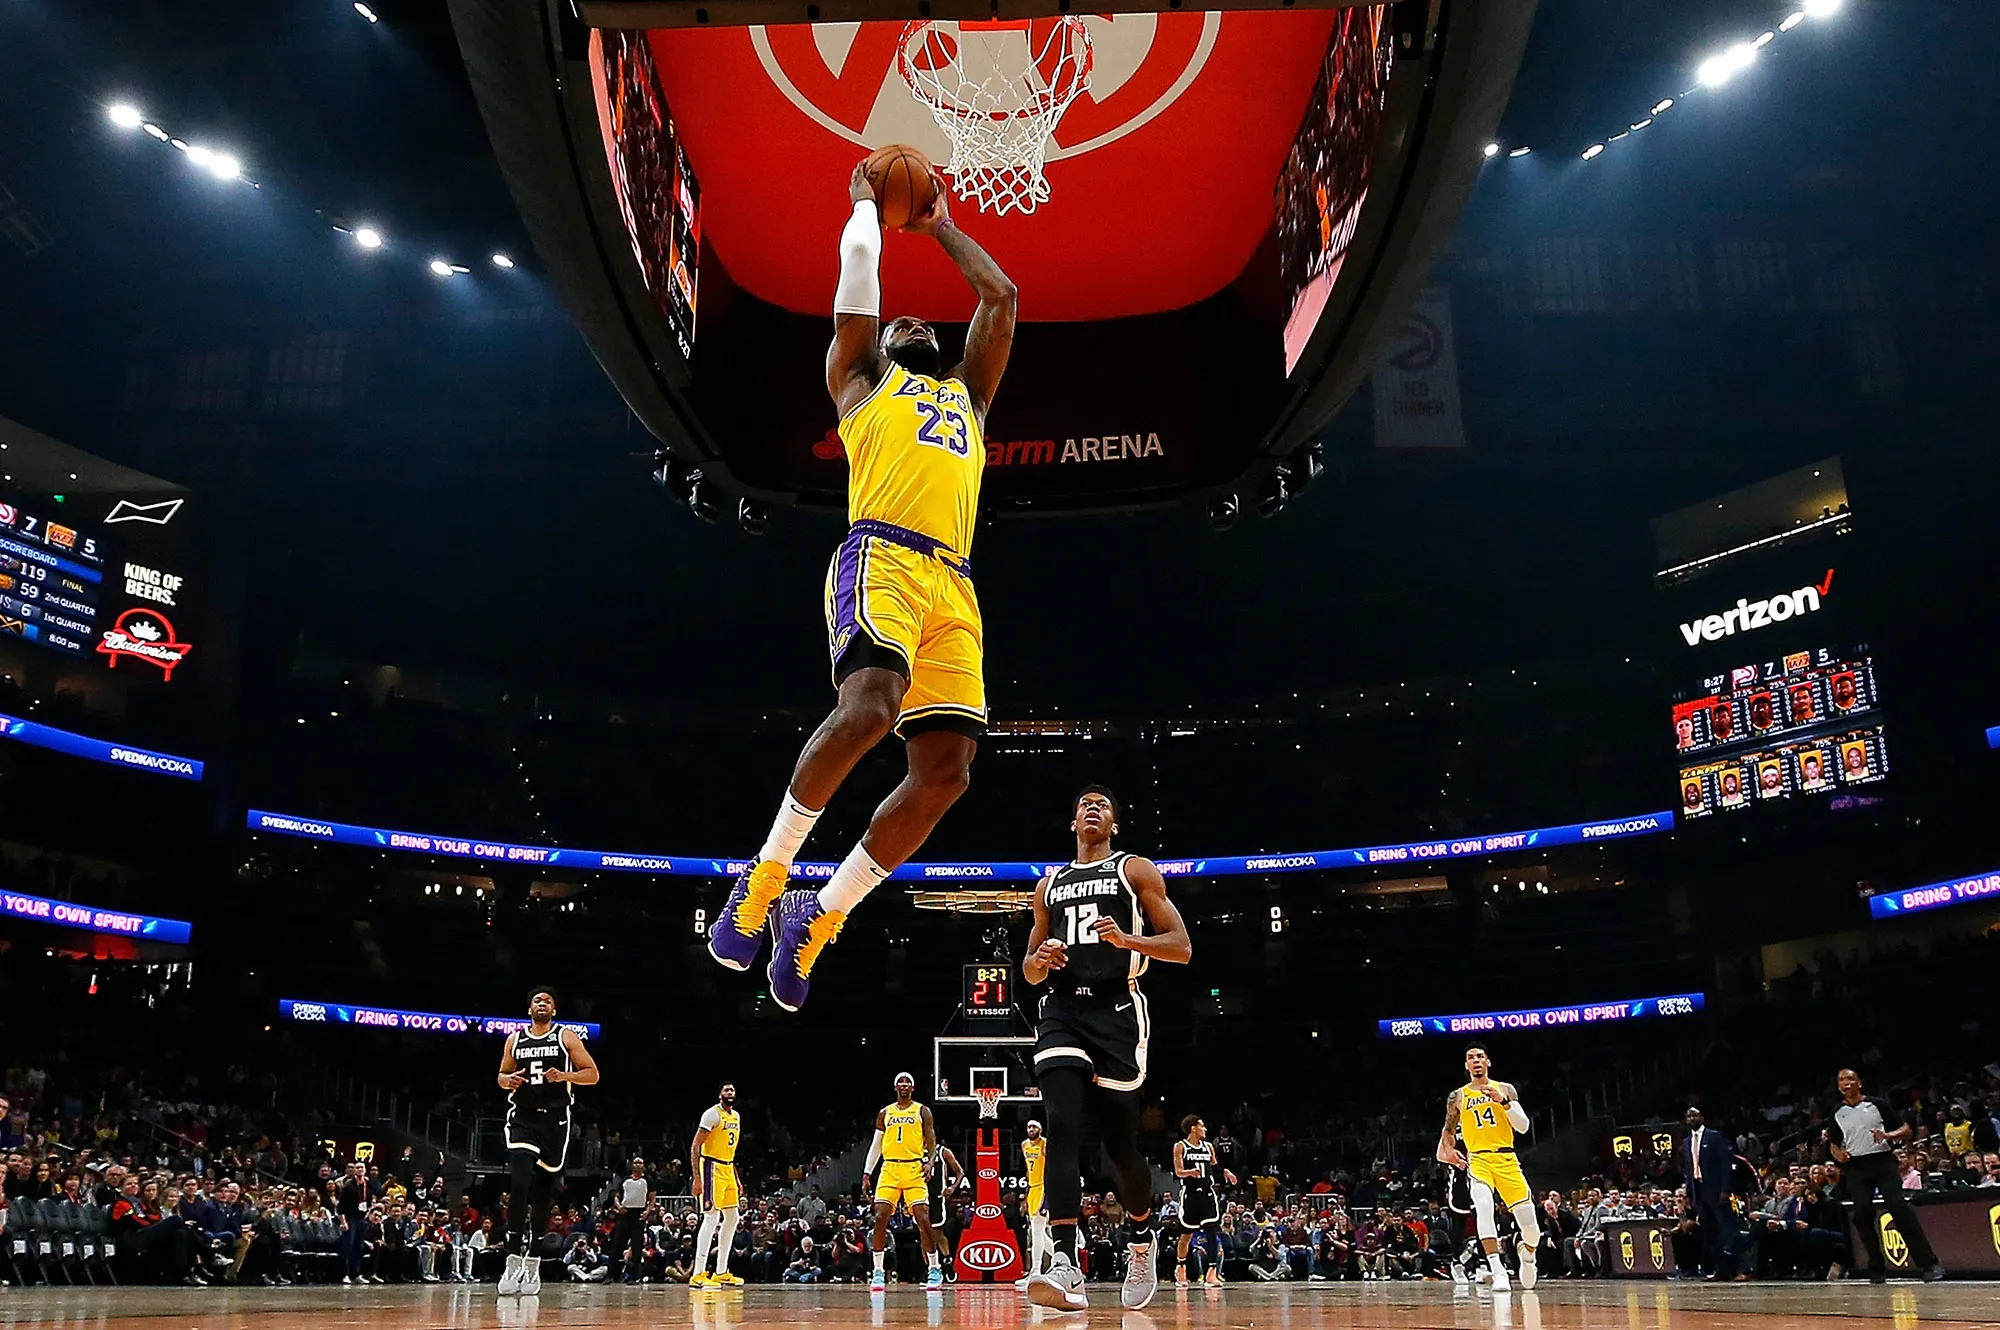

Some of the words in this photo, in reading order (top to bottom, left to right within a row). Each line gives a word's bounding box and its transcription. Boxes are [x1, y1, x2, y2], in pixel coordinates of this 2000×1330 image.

[915, 400, 970, 460] 23
[982, 434, 1056, 467] arm
[1060, 432, 1164, 463] ARENA
[25, 516, 38, 531] 7
[84, 538, 96, 554] 5
[20, 562, 47, 582] 119
[62, 579, 84, 593] FINAL
[124, 562, 161, 585] KING
[162, 572, 184, 590] OF
[20, 582, 39, 599] 59
[60, 596, 96, 617] QUARTER
[125, 579, 177, 606] BEERS.
[21, 603, 32, 617] 6
[56, 615, 91, 635] QUARTER
[1679, 585, 1821, 647] verizon
[103, 631, 184, 661] Budweiser
[1818, 649, 1829, 662] 5
[1703, 675, 1725, 689] 8:27
[1764, 663, 1775, 677] 7
[390, 833, 430, 850] BRING
[432, 839, 470, 855] YOUR
[474, 844, 505, 858] OWN
[507, 848, 549, 862] SPIRIT
[1369, 848, 1408, 862] BRING
[1410, 844, 1448, 857] YOUR
[1451, 840, 1482, 854] OWN
[1485, 835, 1526, 850] SPIRIT
[805, 865, 835, 877] OWN
[1156, 862, 1195, 874] SPIRIT
[1050, 878, 1119, 906] PEACHTREE
[1902, 886, 1951, 908] BRING
[1953, 875, 2000, 898] YOUR
[4, 895, 50, 916] YOUR
[54, 905, 91, 925] OWN
[94, 912, 143, 932] SPIRIT
[1064, 902, 1100, 946] 12
[977, 968, 1007, 982] 8:27
[973, 980, 1005, 1005] 21
[1075, 987, 1094, 996] ATL
[354, 1010, 399, 1026] BRING
[401, 1015, 442, 1029] YOUR
[1451, 1017, 1495, 1032] BRING
[1497, 1013, 1541, 1028] YOUR
[1545, 1010, 1579, 1025] OWN
[1583, 1004, 1629, 1020] SPIRIT
[516, 1045, 559, 1060] PEACHTREE
[530, 1060, 544, 1085] 5
[1473, 1107, 1497, 1128] 14
[727, 1132, 736, 1148] 3
[897, 1126, 904, 1142] 1
[979, 1207, 997, 1215] KIA
[969, 1247, 1006, 1264] KIA
